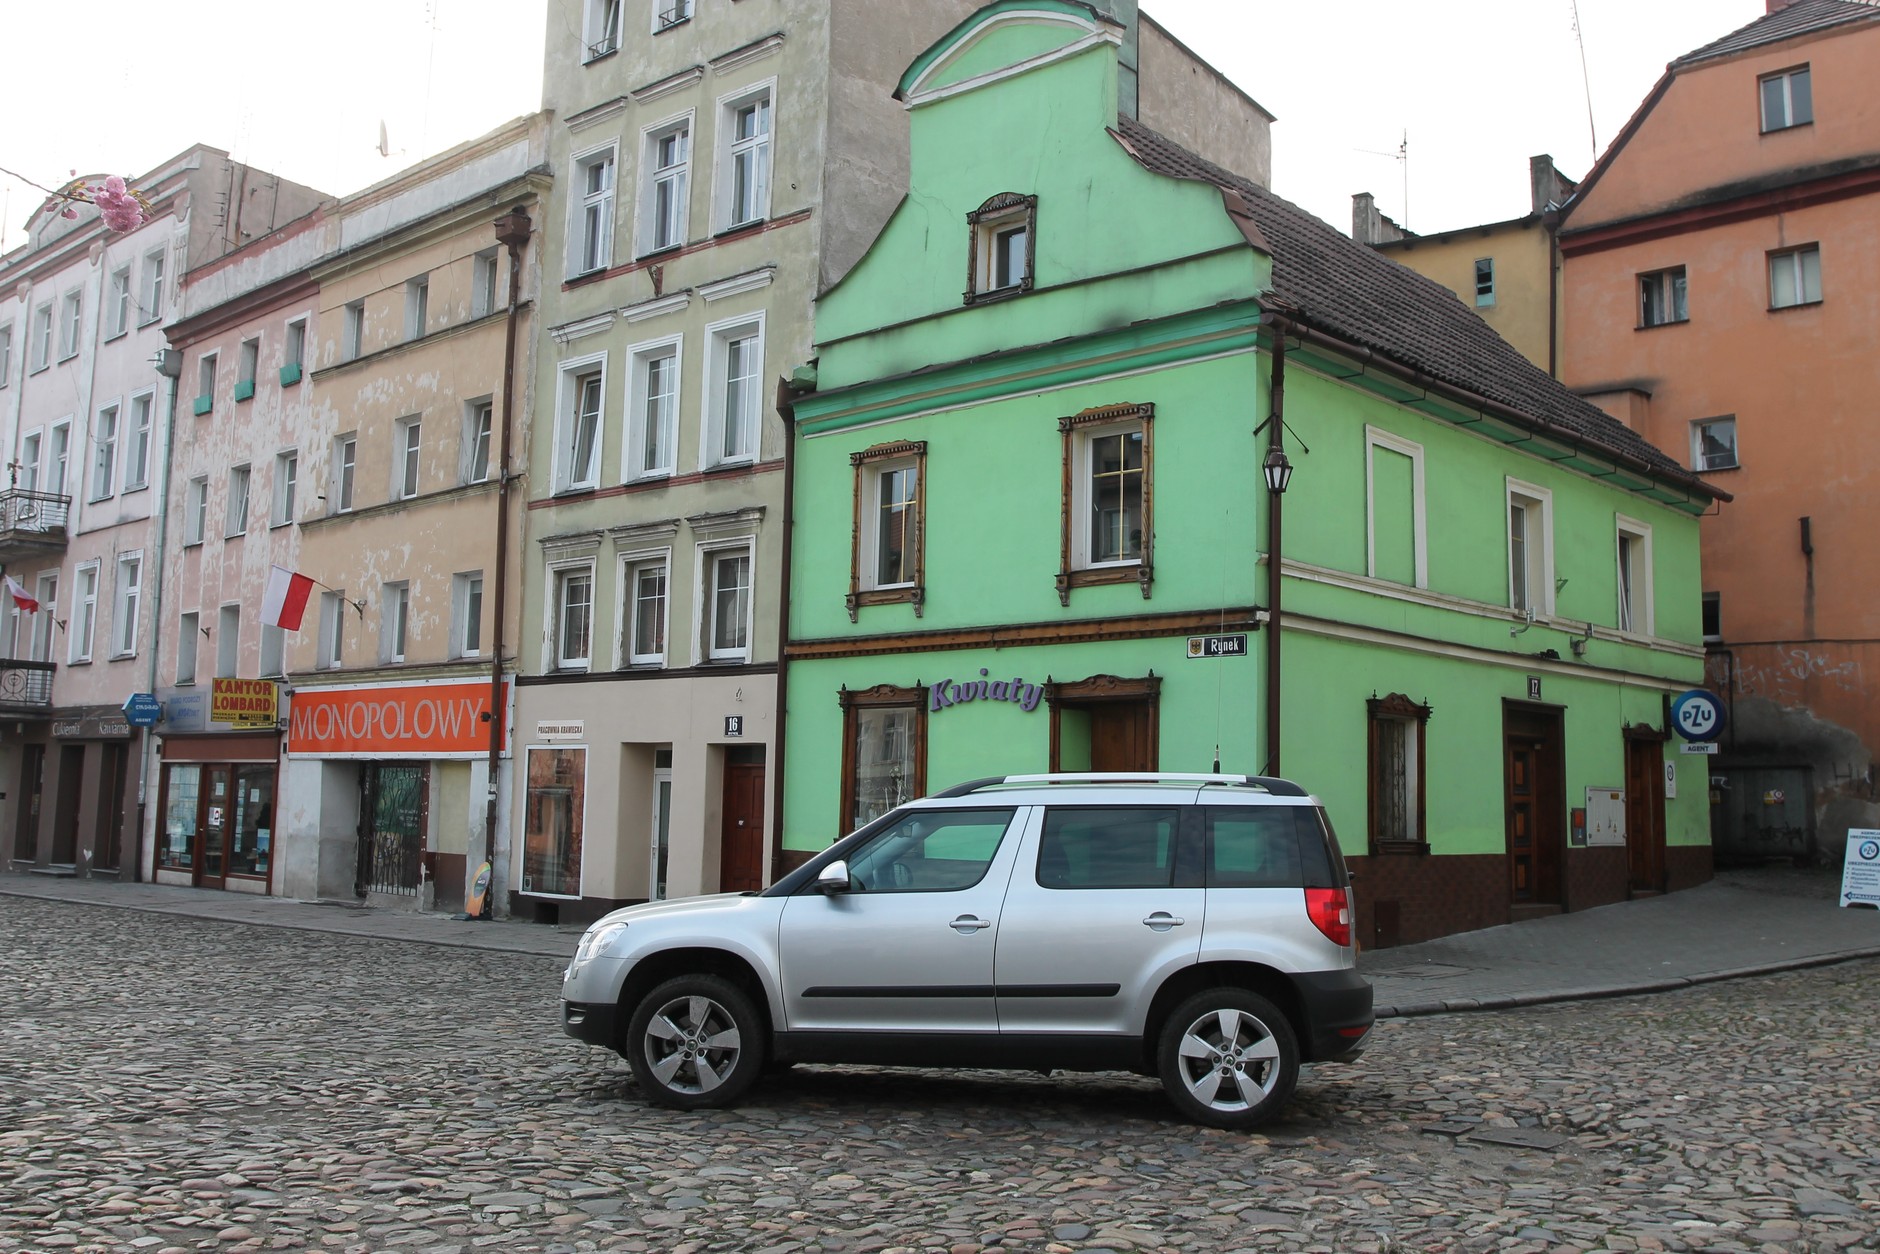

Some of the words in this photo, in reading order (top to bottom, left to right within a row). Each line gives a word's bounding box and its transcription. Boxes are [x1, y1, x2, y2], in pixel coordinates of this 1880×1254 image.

[1210, 637, 1240, 656] Rynek
[214, 679, 272, 696] KANTOR
[929, 667, 1045, 712] Kwiaty
[1531, 679, 1539, 694] 17
[213, 695, 271, 712] LOMBARD
[290, 697, 485, 741] MONOPOLOWY
[728, 717, 738, 732] 16
[1682, 704, 1712, 728] PZU
[52, 721, 80, 736] Cukiernia
[99, 720, 129, 736] Kawiarnia
[537, 725, 560, 735] PRACOWNIA
[1863, 845, 1876, 855] PZU
